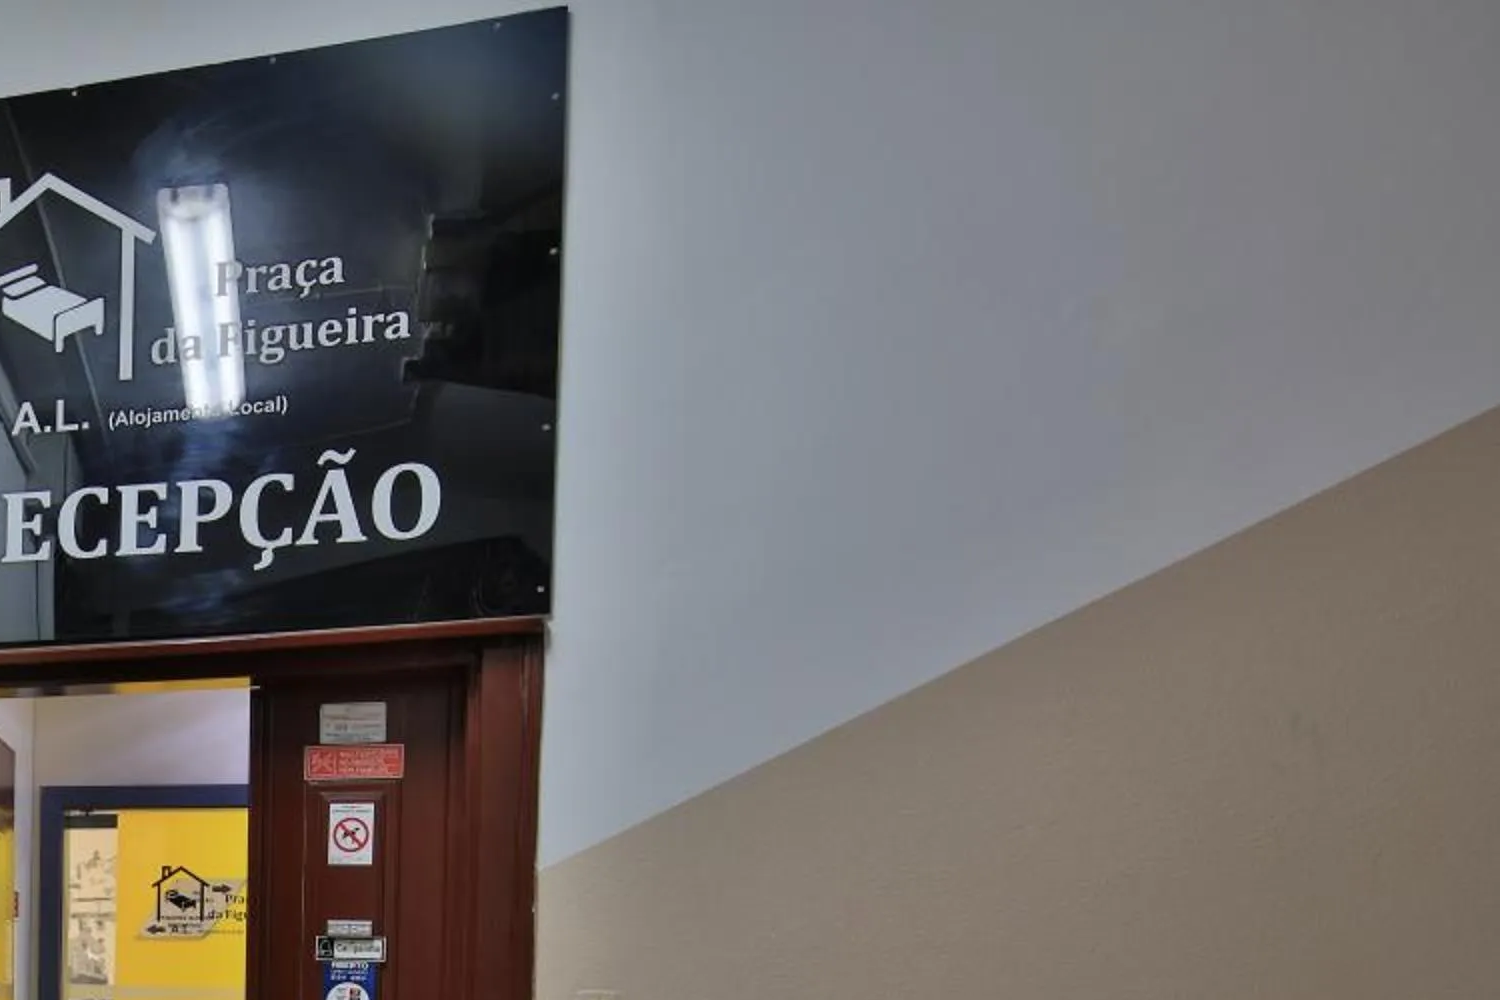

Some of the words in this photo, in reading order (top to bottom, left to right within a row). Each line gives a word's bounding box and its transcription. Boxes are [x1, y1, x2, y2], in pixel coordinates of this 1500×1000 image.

[214, 255, 345, 299] Praça
[151, 327, 203, 366] da
[217, 308, 411, 362] Figueira
[11, 398, 90, 436] A.L.
[108, 404, 222, 431] (Alojament
[229, 395, 288, 416] Local)
